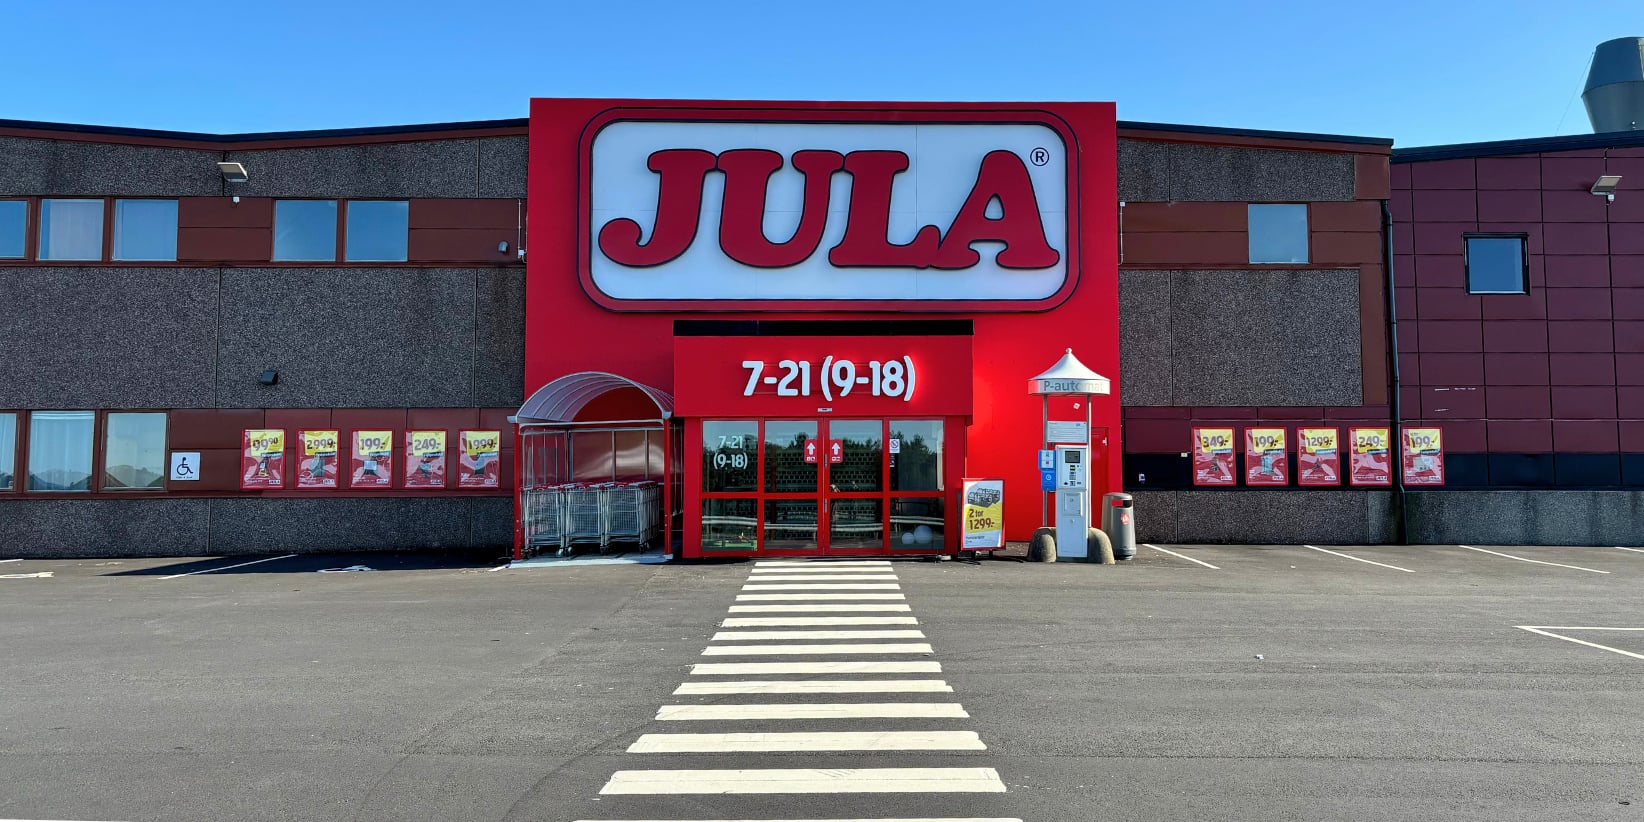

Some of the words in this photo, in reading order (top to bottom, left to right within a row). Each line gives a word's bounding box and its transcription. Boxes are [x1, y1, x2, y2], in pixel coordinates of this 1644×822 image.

[598, 148, 1060, 269] JULA
[742, 360, 811, 397] 7-21
[820, 355, 916, 401] (9-18)
[718, 435, 743, 449] 7-21
[713, 452, 748, 470] (9-18)
[969, 508, 975, 518] 2
